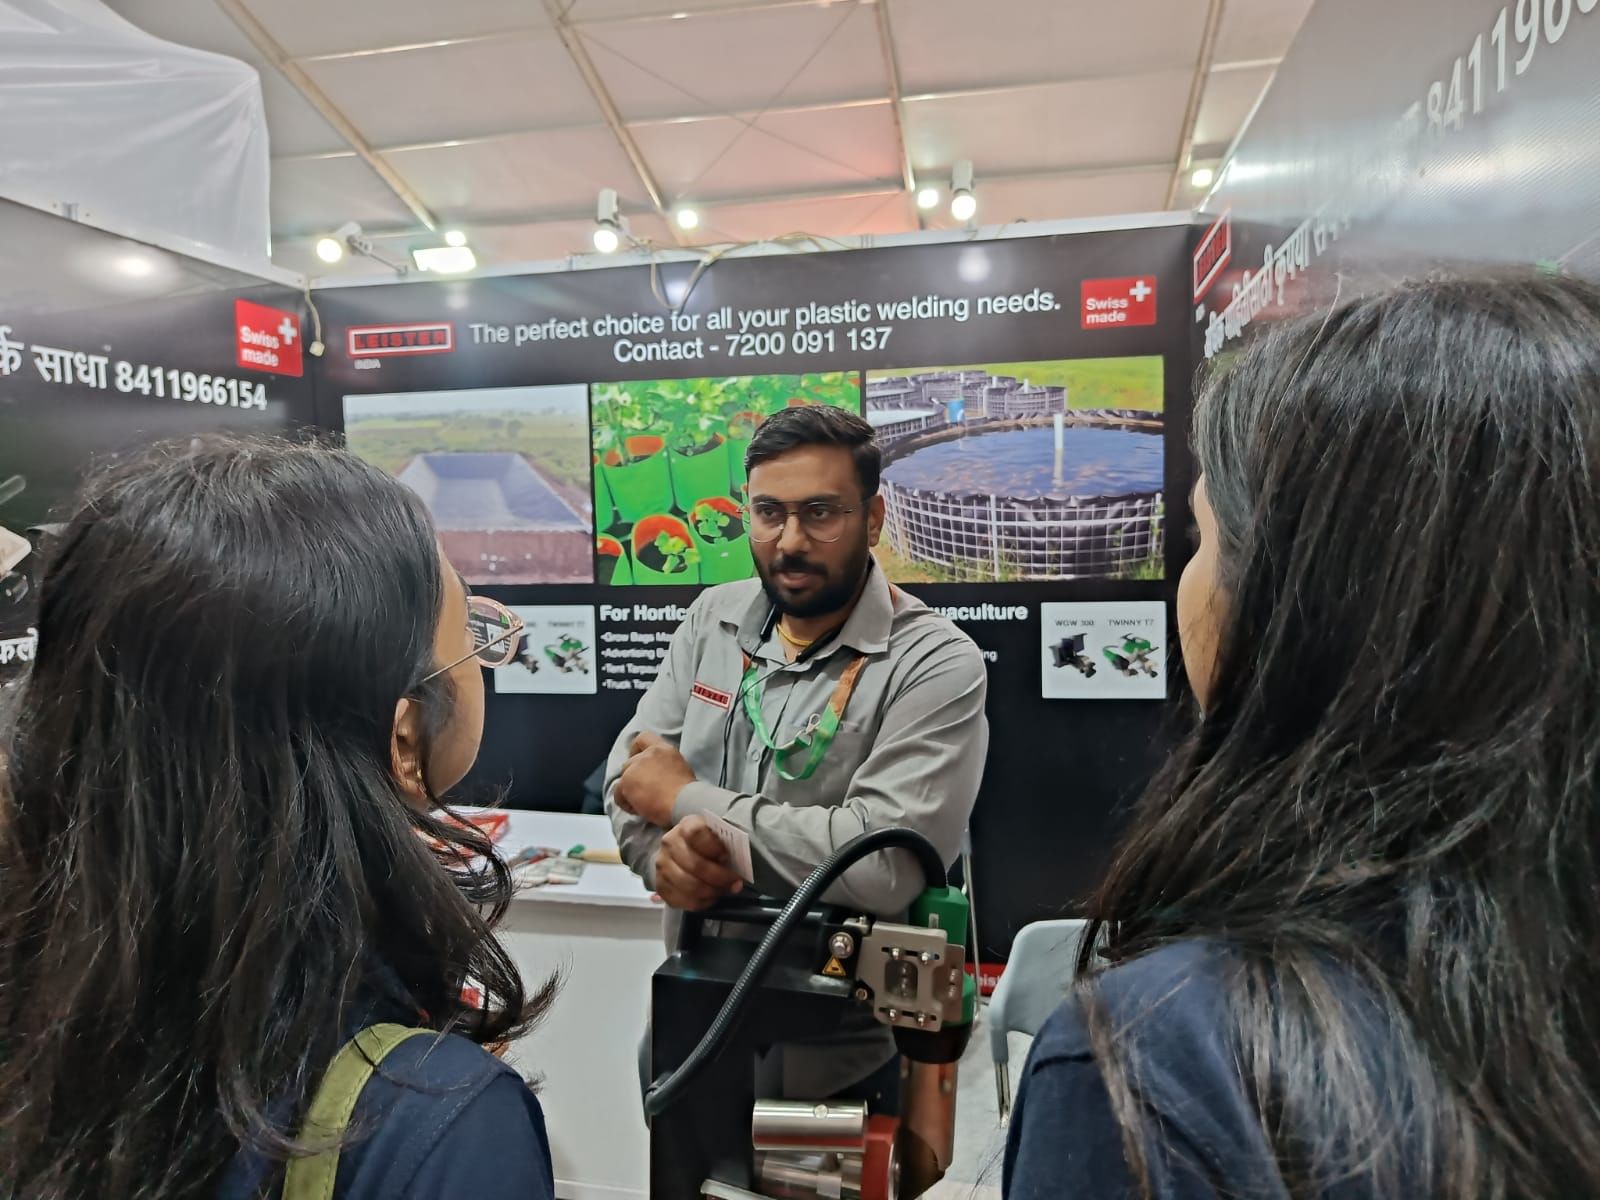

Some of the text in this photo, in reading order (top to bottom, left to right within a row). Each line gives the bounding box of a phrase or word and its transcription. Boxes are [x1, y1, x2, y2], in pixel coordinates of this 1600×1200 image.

[1085, 297, 1129, 311] Swiss
[469, 288, 1061, 346] The perfect choice for all your plastic welding needs.
[1086, 310, 1127, 324] made
[240, 326, 280, 349] Swiss
[354, 330, 445, 350] LEISTER
[613, 337, 704, 363] Contact
[724, 332, 786, 357] 7200
[791, 330, 836, 353] 091
[846, 326, 893, 351] 137
[241, 348, 279, 367] made
[30, 344, 108, 390] साधा
[114, 360, 268, 411] 8411966154
[600, 604, 630, 621] For
[929, 602, 1029, 620] uaculture
